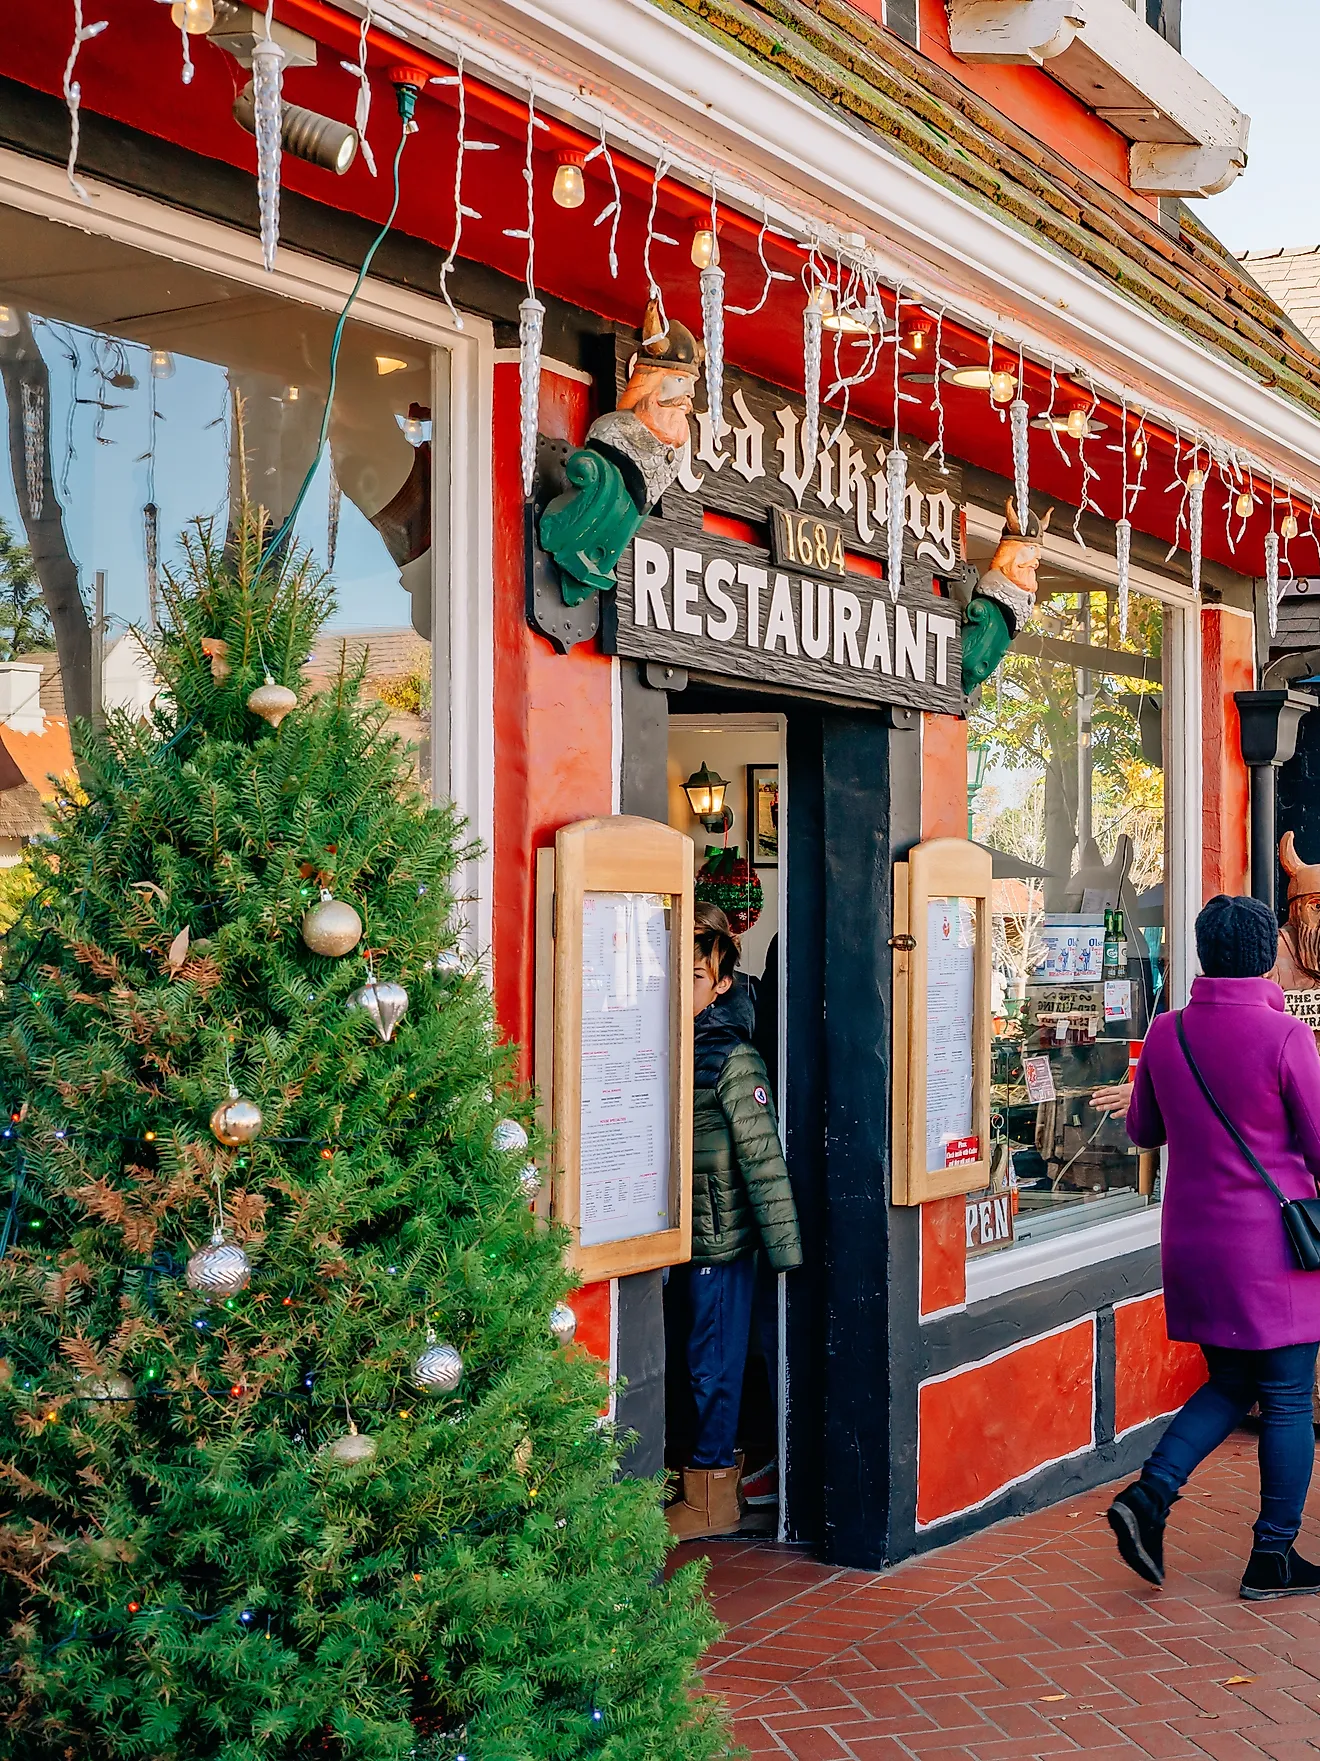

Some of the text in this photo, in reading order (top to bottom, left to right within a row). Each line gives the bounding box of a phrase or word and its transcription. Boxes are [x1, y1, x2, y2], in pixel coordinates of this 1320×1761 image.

[783, 513, 846, 576] 1684
[633, 537, 956, 686] RESTAURANT
[1284, 994, 1312, 1004] THE
[966, 1197, 1010, 1249] PEN
